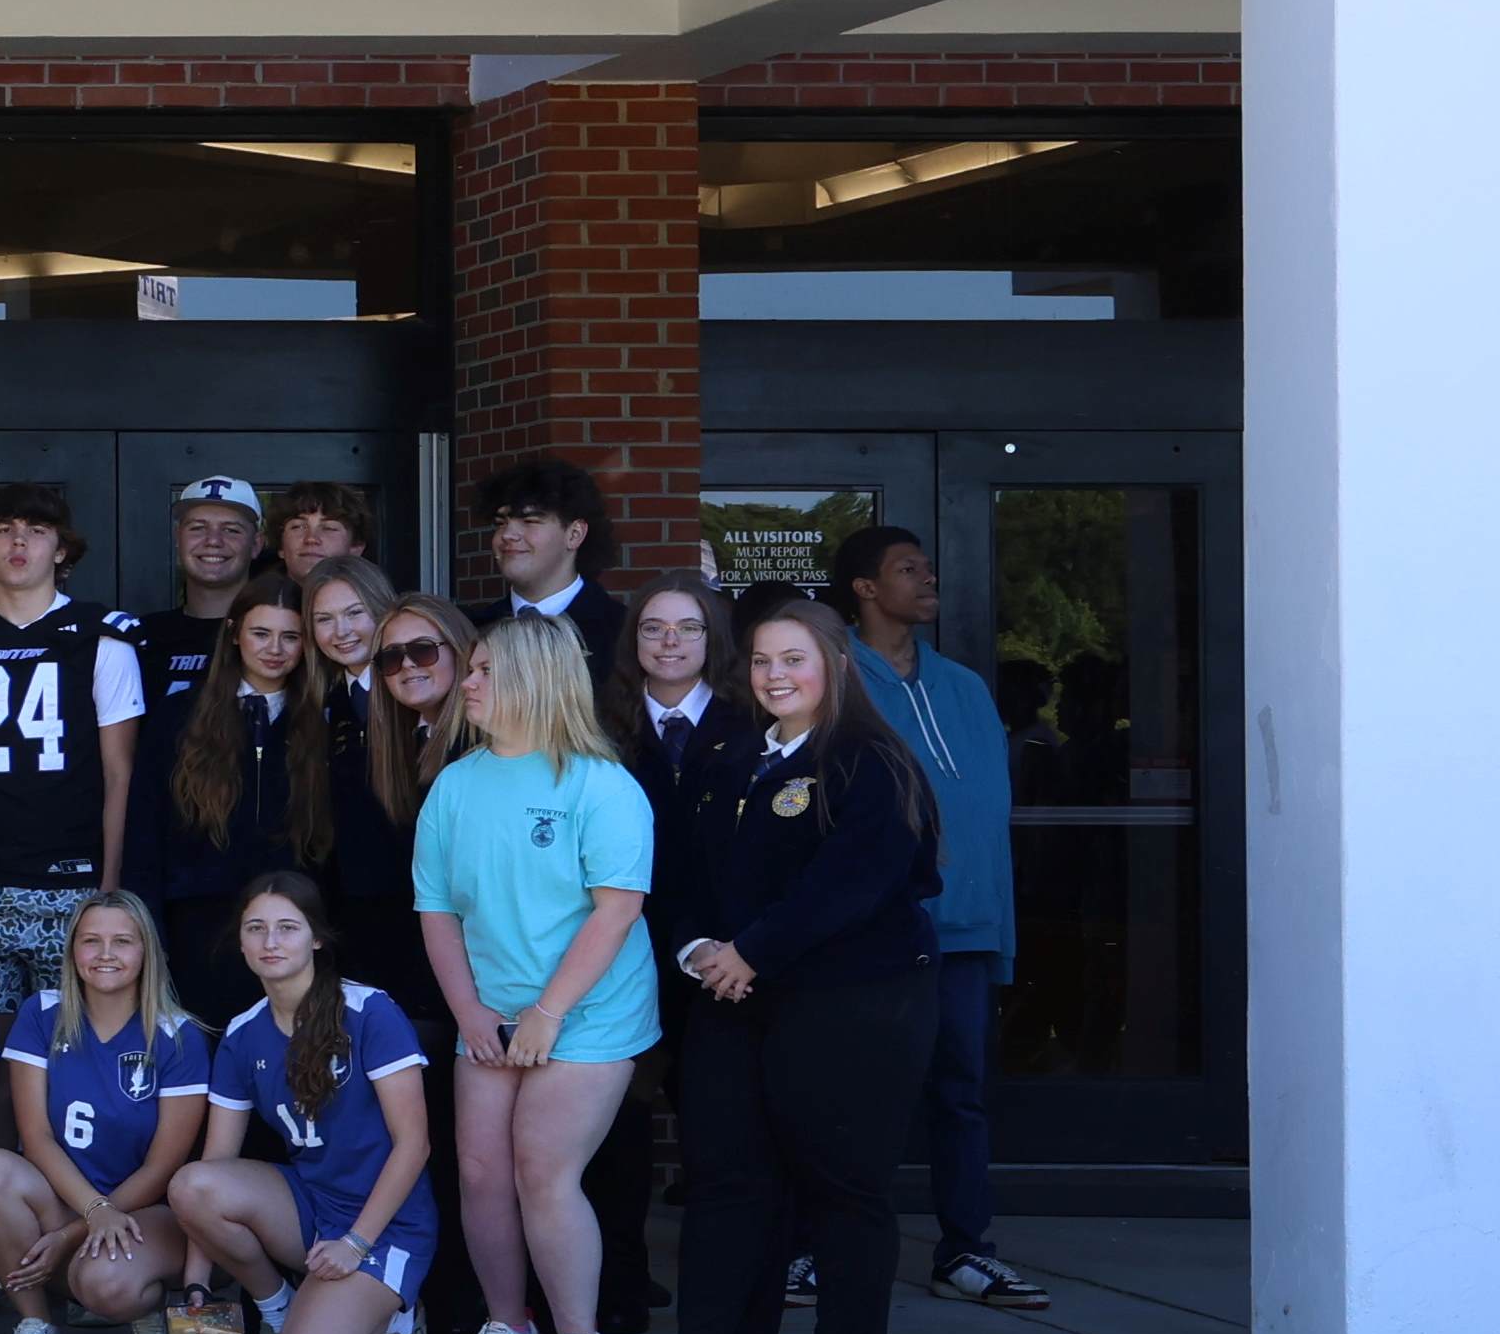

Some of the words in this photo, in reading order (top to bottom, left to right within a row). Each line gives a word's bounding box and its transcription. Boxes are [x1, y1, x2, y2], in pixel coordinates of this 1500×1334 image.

[201, 480, 232, 500] T
[723, 531, 749, 544] ALL
[753, 530, 824, 544] VISITORS
[736, 546, 766, 558] MUST
[771, 546, 811, 557] REPORT
[733, 558, 749, 570] TO
[752, 558, 773, 569] THE
[777, 558, 815, 570] OFFICE
[720, 570, 742, 582] FOR
[744, 571, 751, 581] A
[754, 570, 801, 582] VISITOR'S
[803, 570, 828, 582] PASS
[168, 655, 207, 670] TRIT
[63, 1100, 95, 1150] 6
